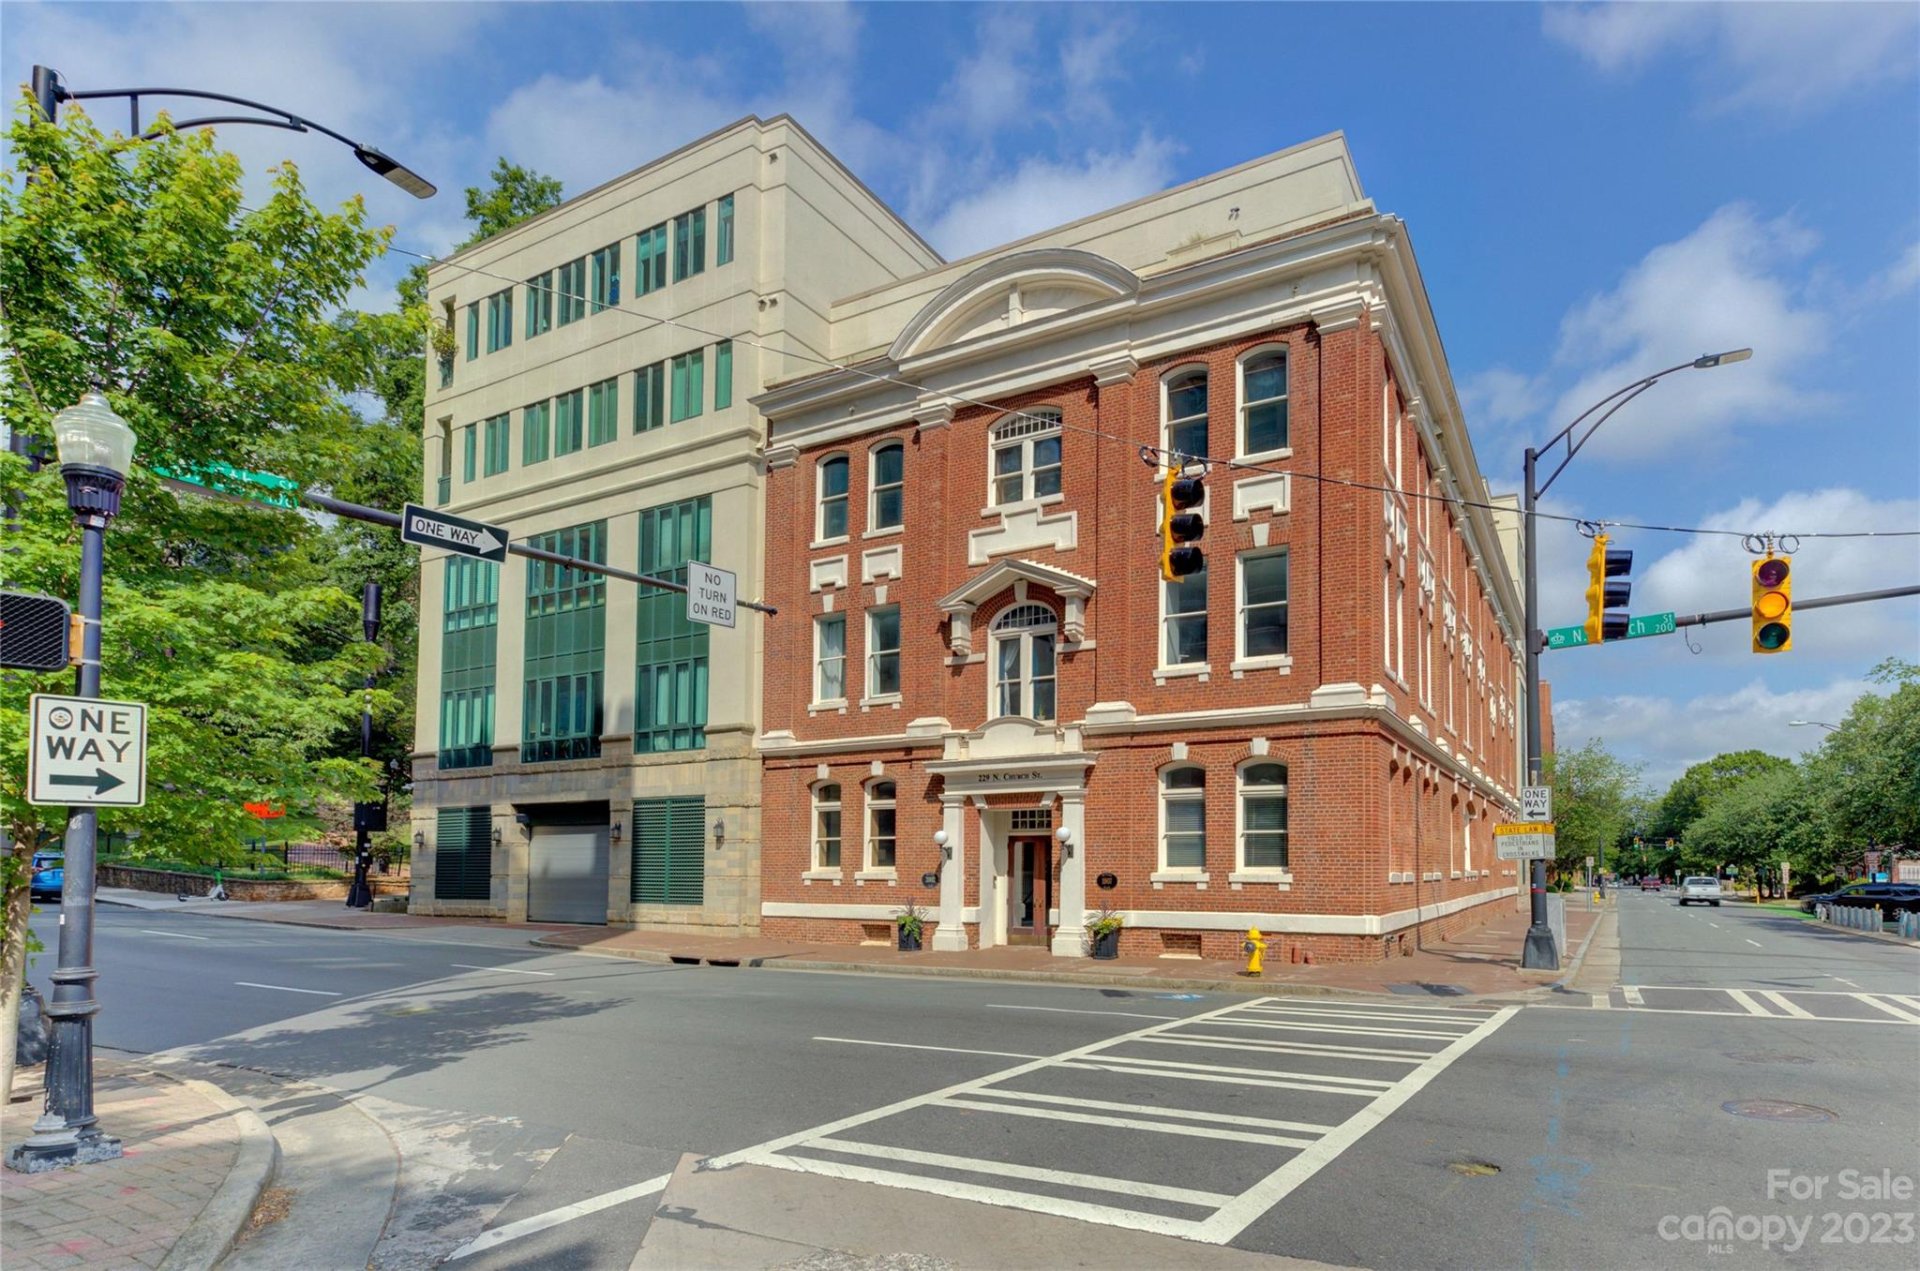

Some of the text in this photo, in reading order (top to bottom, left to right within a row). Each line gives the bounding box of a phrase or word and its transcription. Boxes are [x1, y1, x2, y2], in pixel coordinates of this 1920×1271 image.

[415, 519, 479, 545] ONE WAY
[705, 572, 721, 586] NO
[699, 586, 727, 604] TURN
[693, 602, 731, 620] ON RED
[1663, 614, 1673, 624] St
[1655, 623, 1674, 633] 200
[1572, 629, 1587, 643] N.
[48, 706, 130, 735] ONE
[46, 735, 132, 763] WAY
[978, 773, 990, 782] 229
[1524, 789, 1547, 799] ONE
[1524, 799, 1547, 808] WAY
